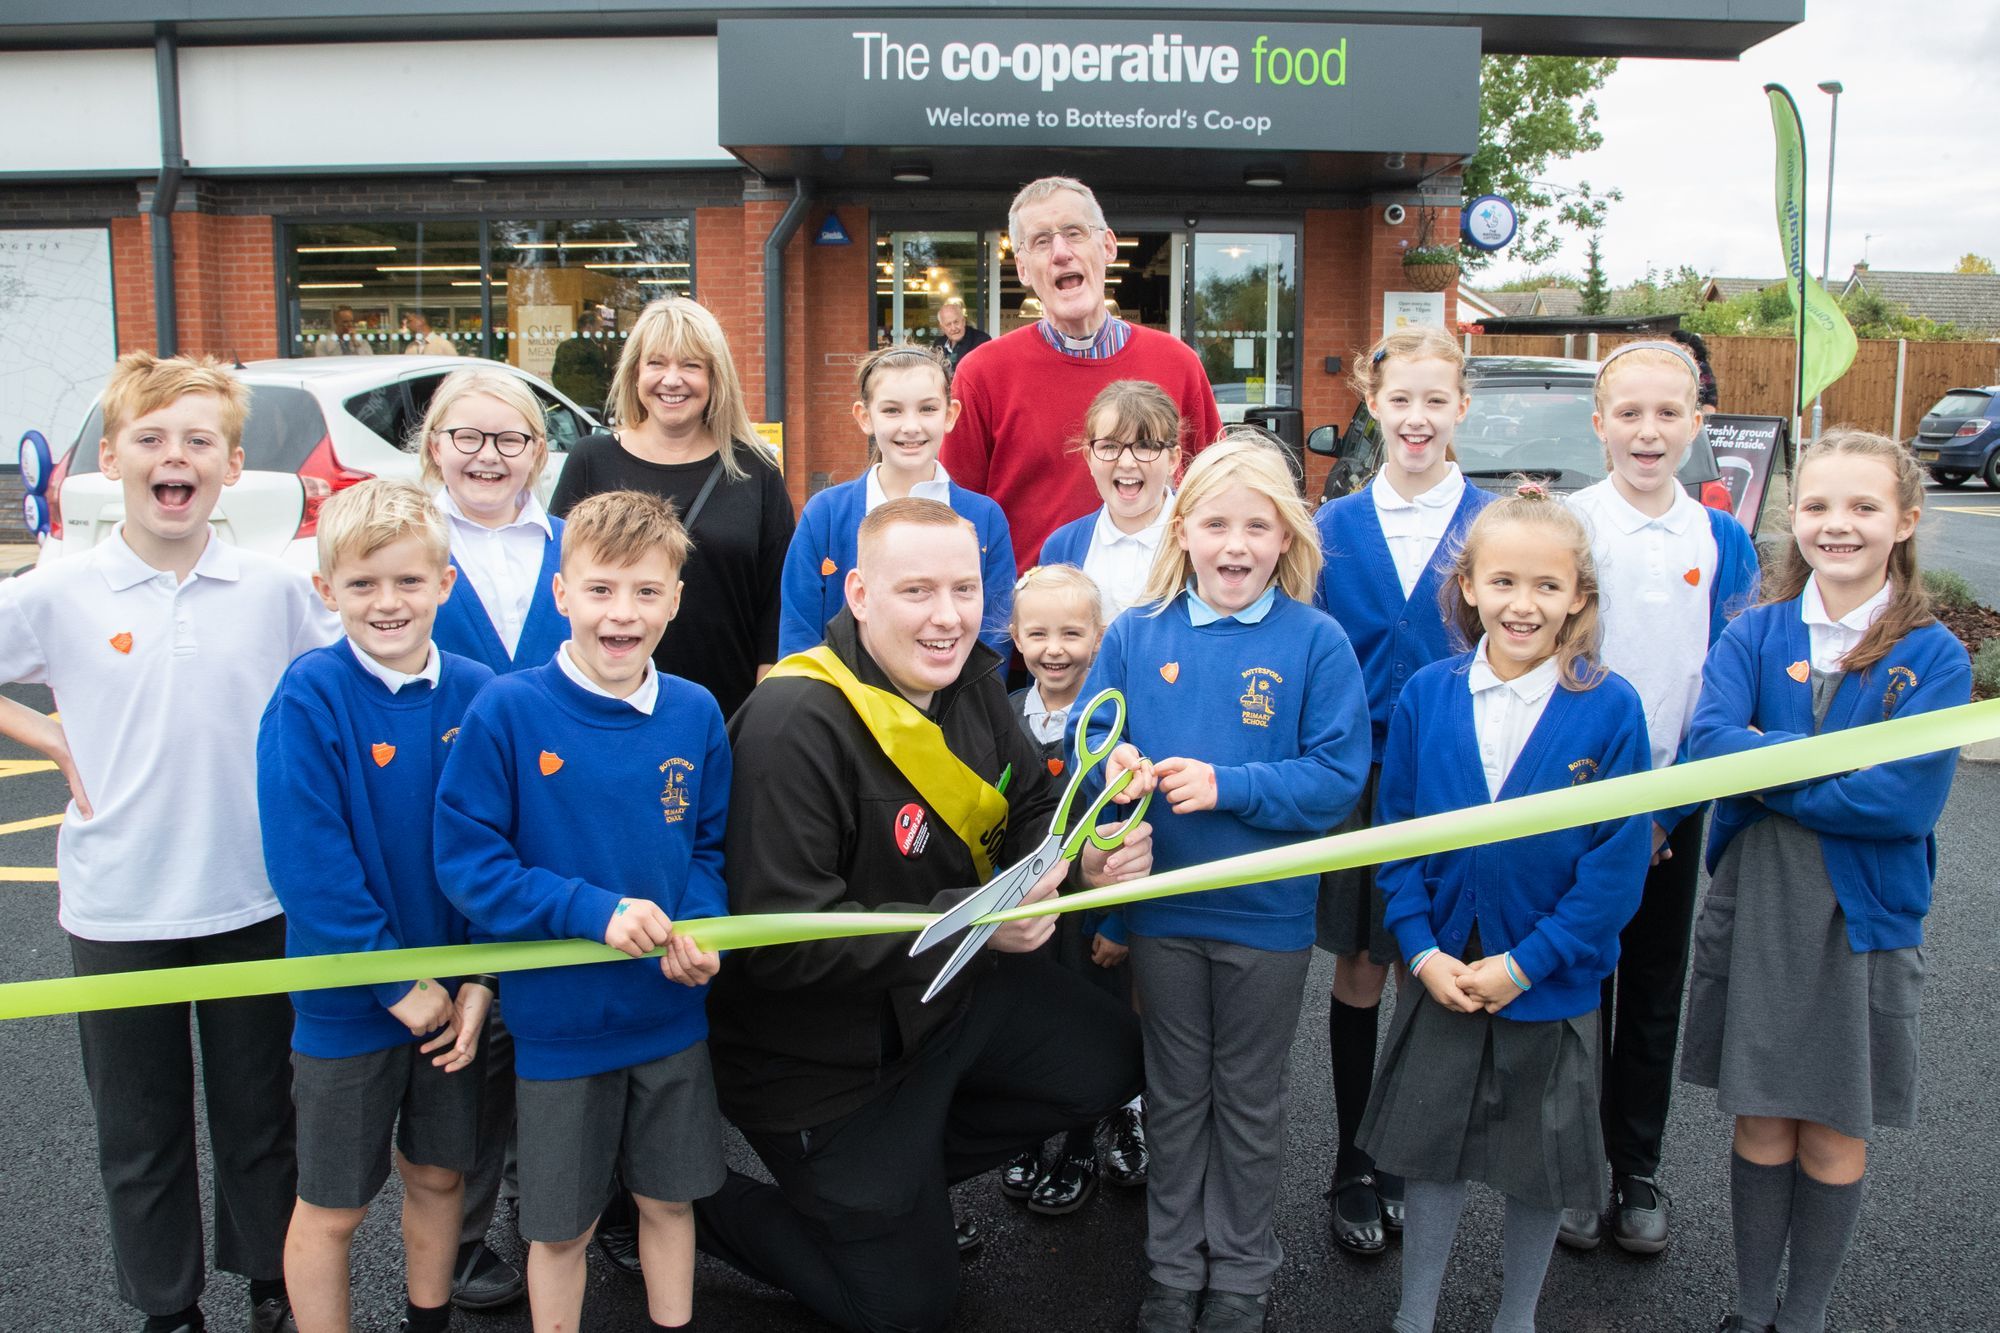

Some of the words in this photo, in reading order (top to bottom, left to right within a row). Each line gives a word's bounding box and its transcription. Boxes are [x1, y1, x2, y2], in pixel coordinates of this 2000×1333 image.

[853, 32, 930, 81] The
[941, 34, 1239, 92] co-operative
[1251, 36, 1347, 86] food
[925, 107, 1030, 128] Welcome
[1036, 110, 1060, 128] to
[1066, 108, 1197, 130] Bottesford's
[1204, 110, 1271, 136] Co-op
[528, 324, 562, 338] ONE
[1738, 427, 1776, 441] ground
[1711, 437, 1734, 448] offee
[1735, 439, 1767, 450] inside.
[1241, 667, 1283, 684] BOTTESFORD
[1242, 710, 1272, 721] PRIMARY
[1242, 717, 1269, 727] SCHOOL
[902, 822, 918, 851] UNDER
